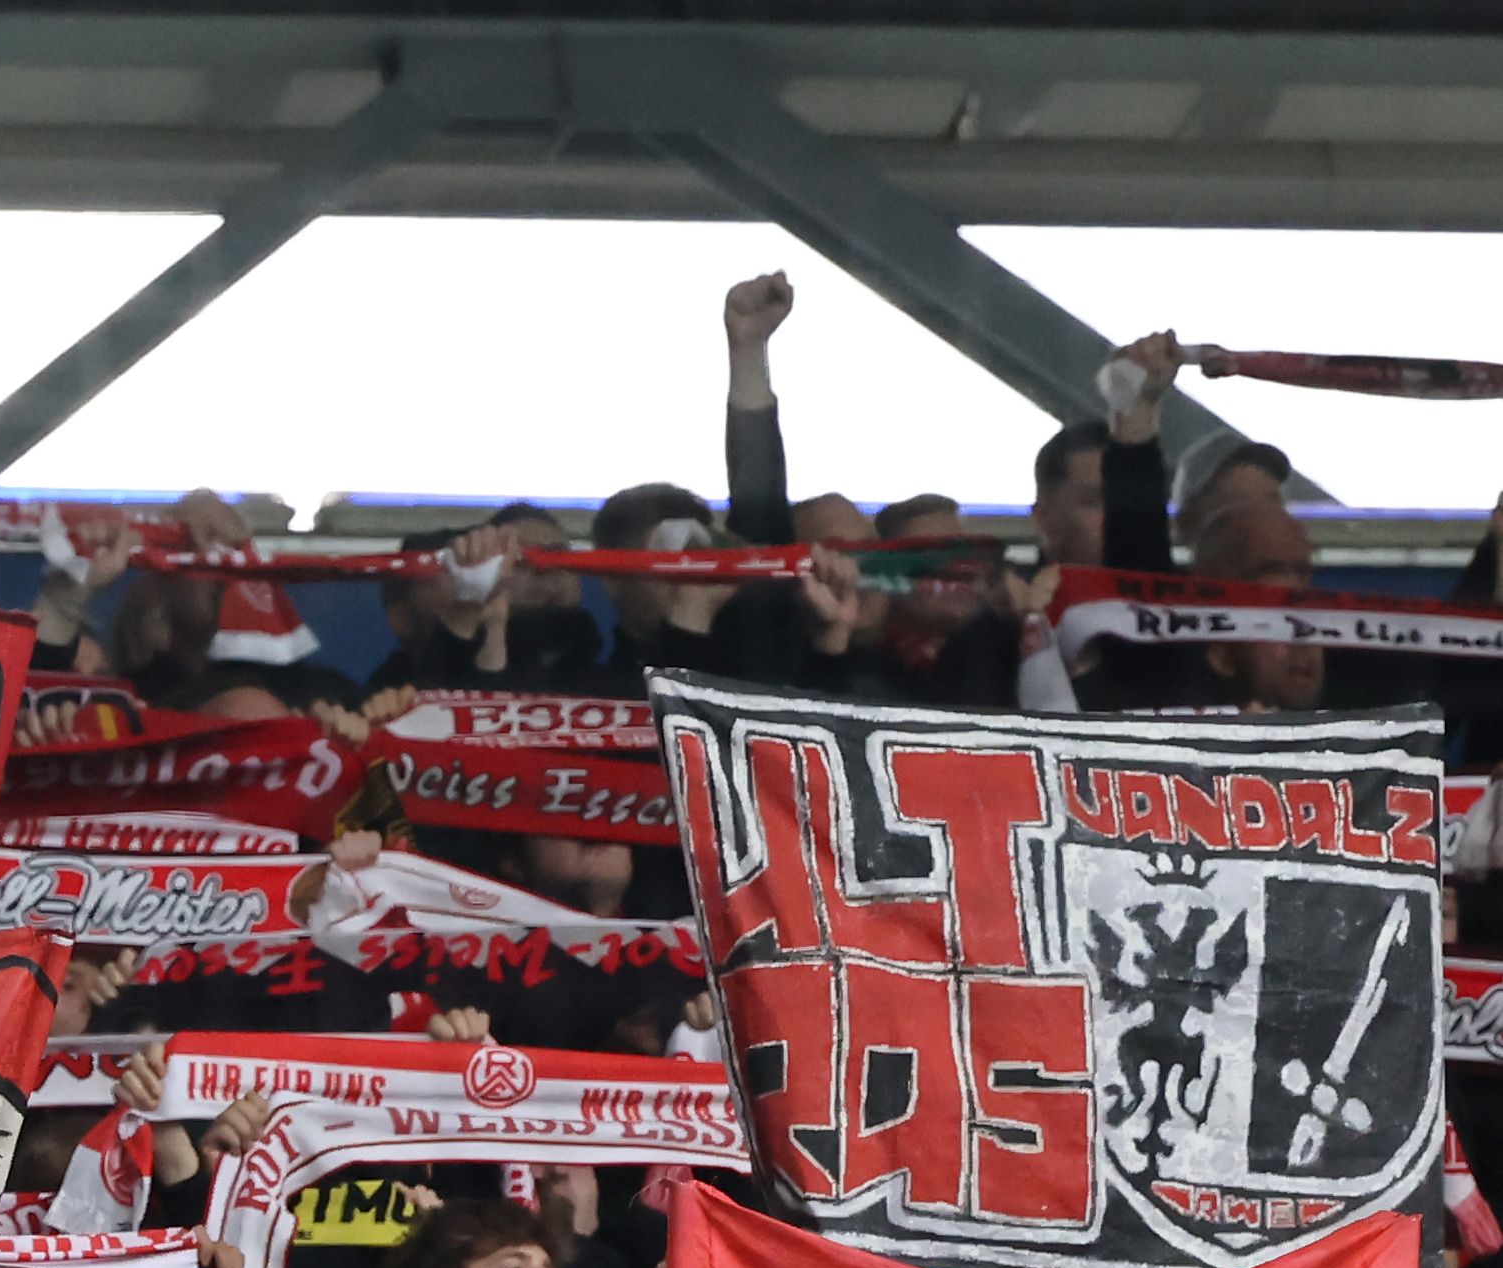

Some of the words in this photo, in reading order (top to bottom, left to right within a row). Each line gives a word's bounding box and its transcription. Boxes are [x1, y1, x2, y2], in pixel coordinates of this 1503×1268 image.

[1061, 761, 1437, 864] VANDALZ
[188, 1062, 243, 1101] IHR
[254, 1063, 311, 1101] FÜR
[324, 1072, 387, 1107] UNS
[581, 1087, 643, 1124] WIR
[235, 1116, 302, 1213] ROT
